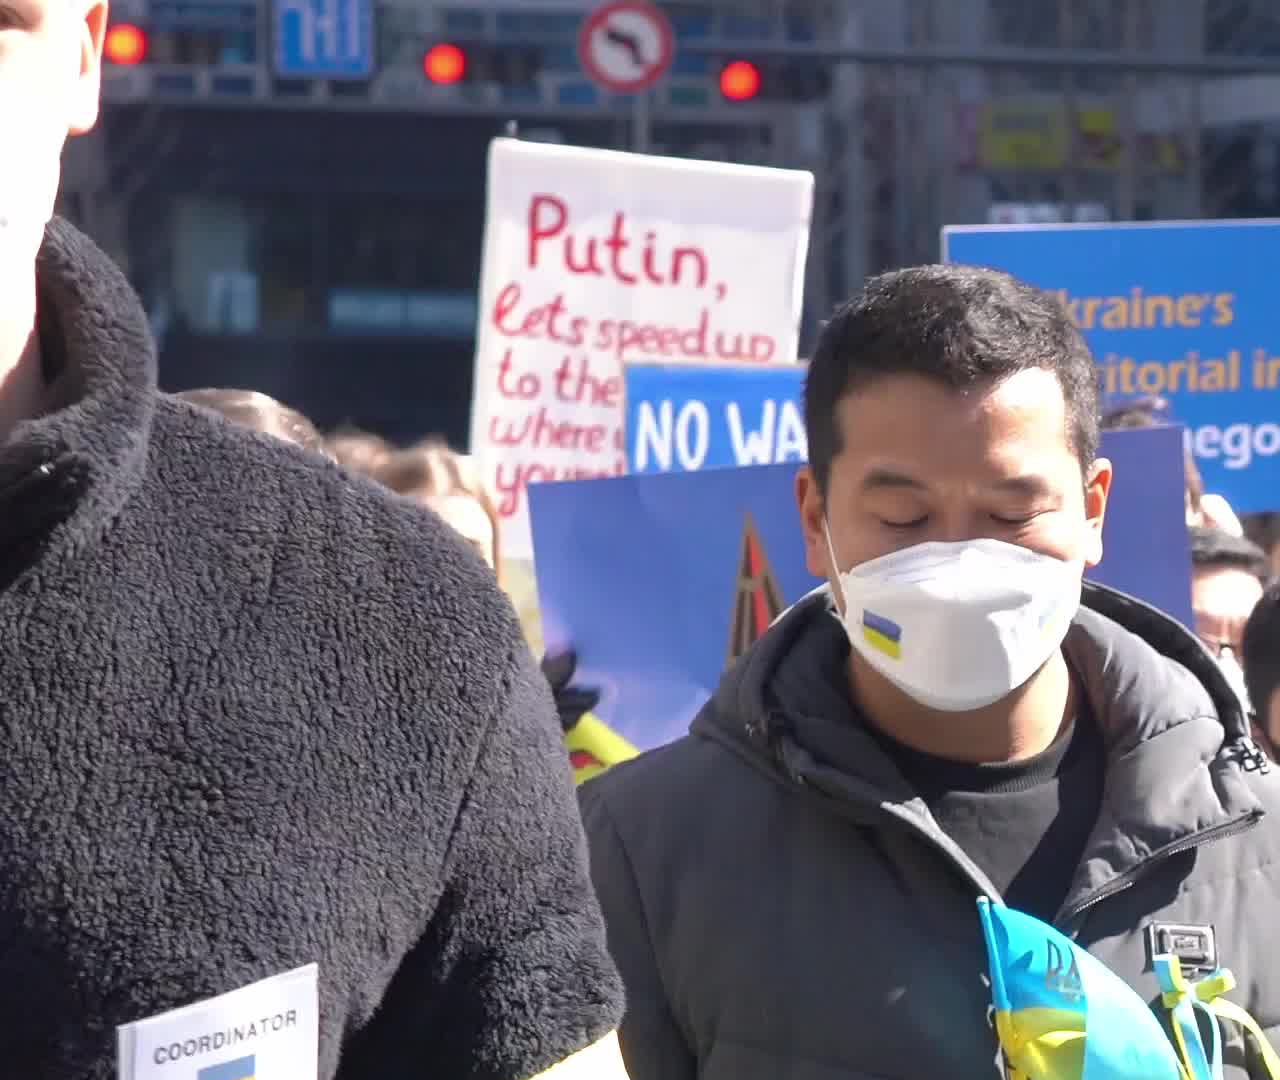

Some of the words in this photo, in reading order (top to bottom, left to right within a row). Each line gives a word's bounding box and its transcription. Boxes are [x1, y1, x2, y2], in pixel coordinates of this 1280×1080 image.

[528, 192, 727, 302] Putin,
[492, 281, 588, 347] lets
[595, 307, 707, 360] speed
[1056, 287, 1235, 329] kraine's
[497, 349, 541, 400] to
[555, 356, 620, 407] the
[1103, 351, 1241, 393] itorial
[488, 407, 607, 453] where
[634, 399, 710, 472] NO
[726, 398, 808, 465] WA
[153, 1009, 298, 1065] COORDINATOR
